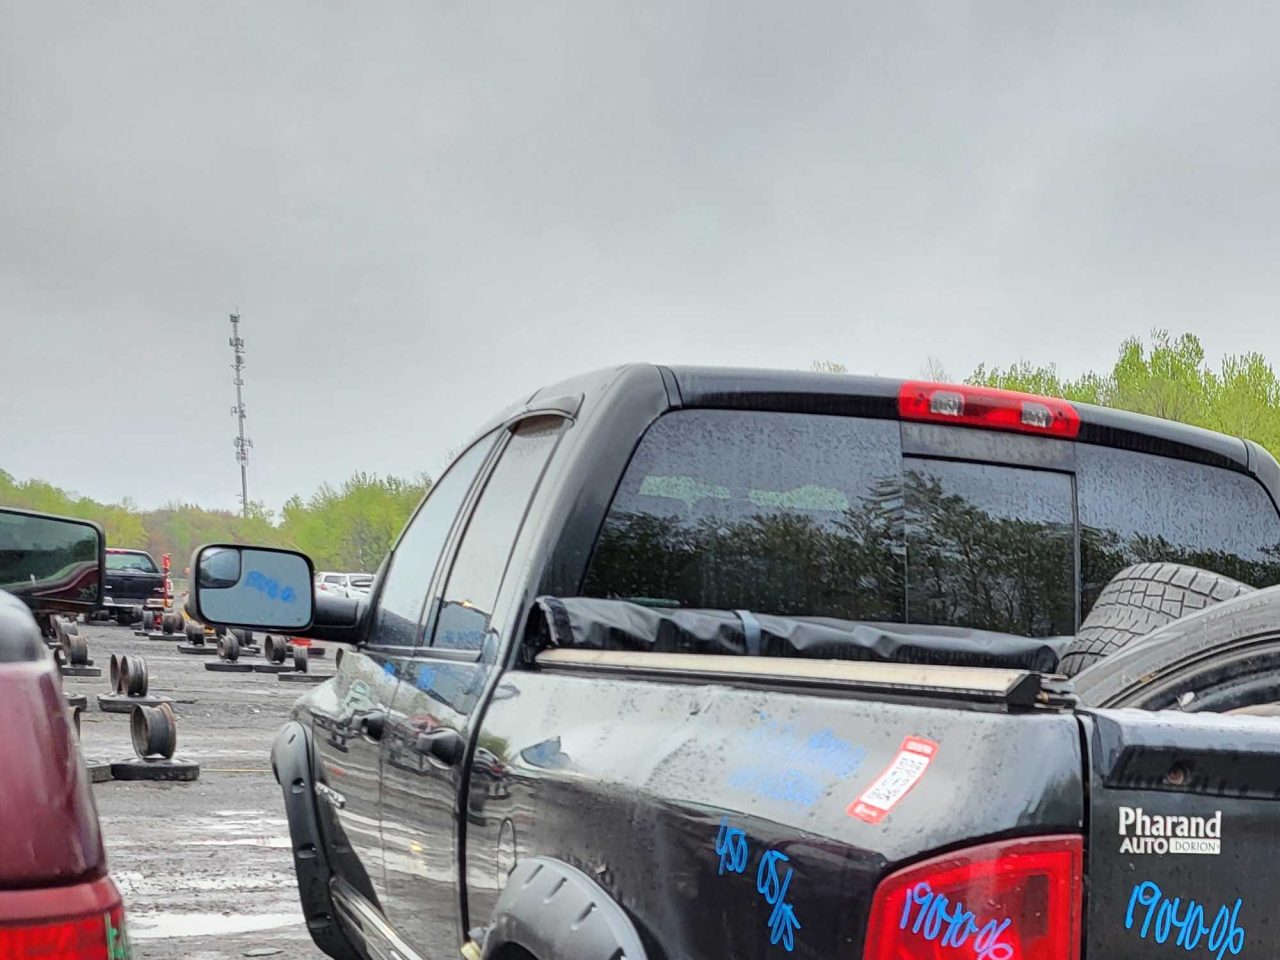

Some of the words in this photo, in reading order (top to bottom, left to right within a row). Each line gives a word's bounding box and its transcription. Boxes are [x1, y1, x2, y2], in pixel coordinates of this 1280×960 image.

[1118, 806, 1223, 838] Pharand
[1119, 836, 1170, 855] AUTO
[1174, 840, 1219, 853] DORION
